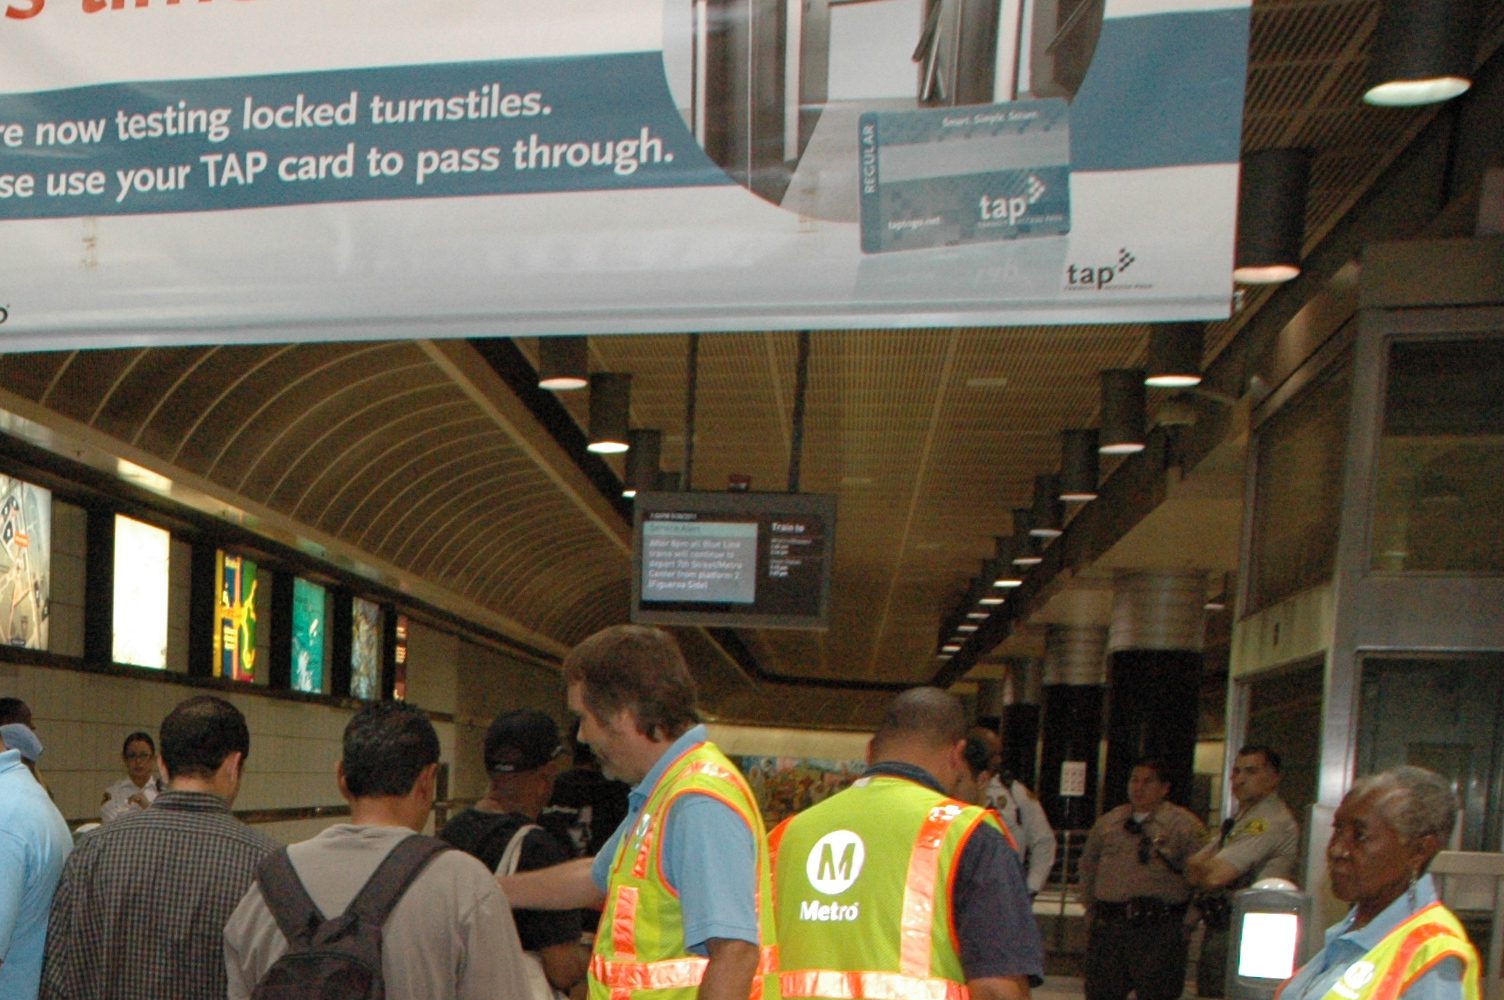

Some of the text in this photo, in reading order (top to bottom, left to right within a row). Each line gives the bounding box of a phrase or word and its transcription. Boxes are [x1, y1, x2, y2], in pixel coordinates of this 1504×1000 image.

[35, 118, 106, 147] now
[115, 99, 232, 142] testing
[242, 91, 358, 131] locked
[369, 83, 553, 124] turnstiles.
[45, 170, 106, 197] use
[116, 165, 191, 203] your
[199, 151, 268, 188] TAP
[277, 143, 356, 181] card
[366, 147, 401, 177] to
[415, 146, 501, 186] pass
[512, 126, 674, 176] through.
[863, 124, 876, 194] REGULAR
[979, 194, 1028, 226] tap
[1067, 264, 1115, 290] tap
[816, 842, 857, 881] M
[799, 899, 860, 921] Metro
